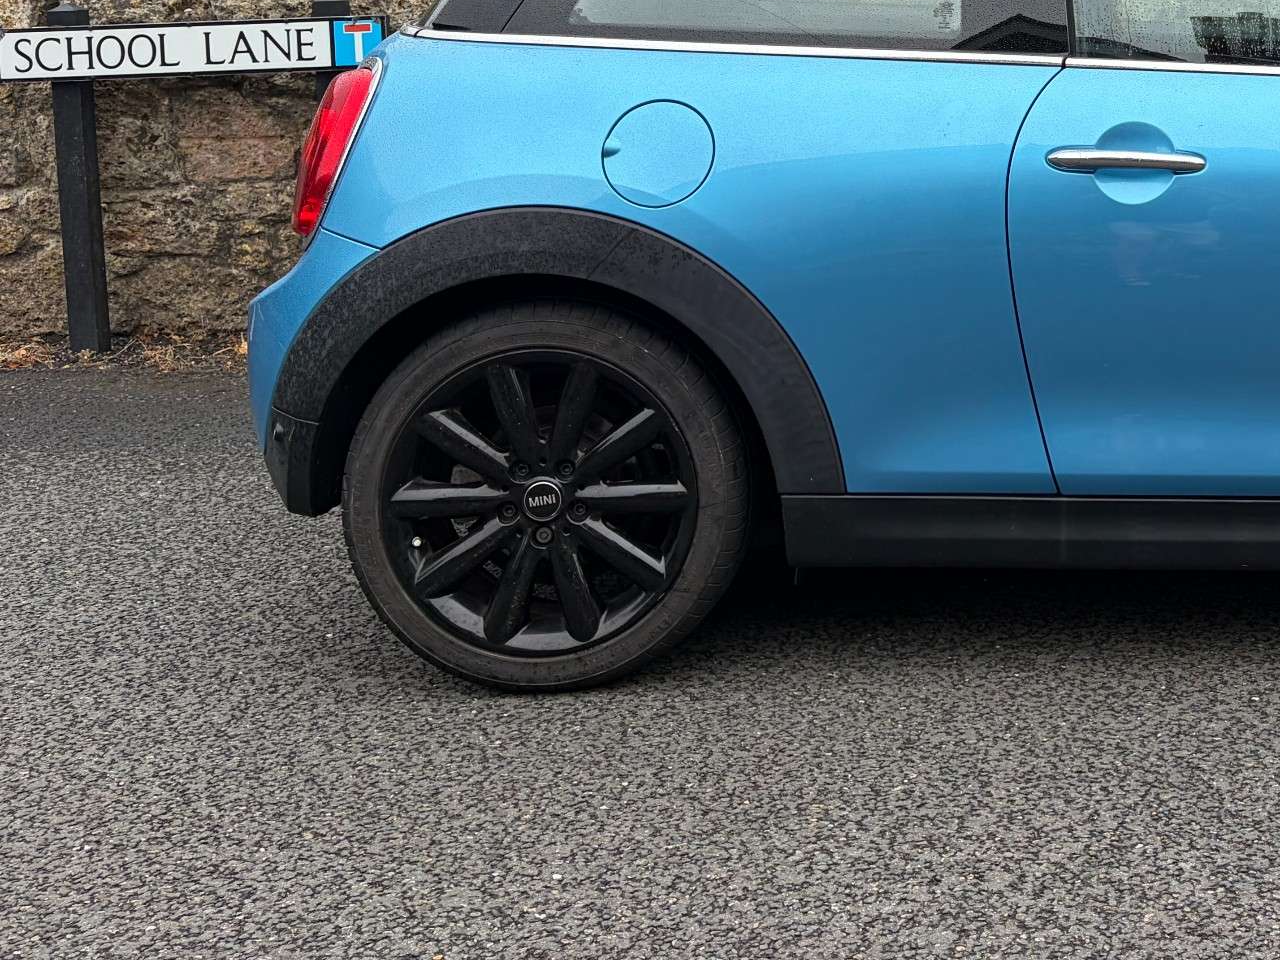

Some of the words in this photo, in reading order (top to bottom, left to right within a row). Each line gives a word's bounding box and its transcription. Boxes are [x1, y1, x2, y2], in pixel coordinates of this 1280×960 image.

[14, 33, 180, 73] SCHOOL
[204, 27, 317, 66] LANE
[528, 493, 556, 507] MINI
